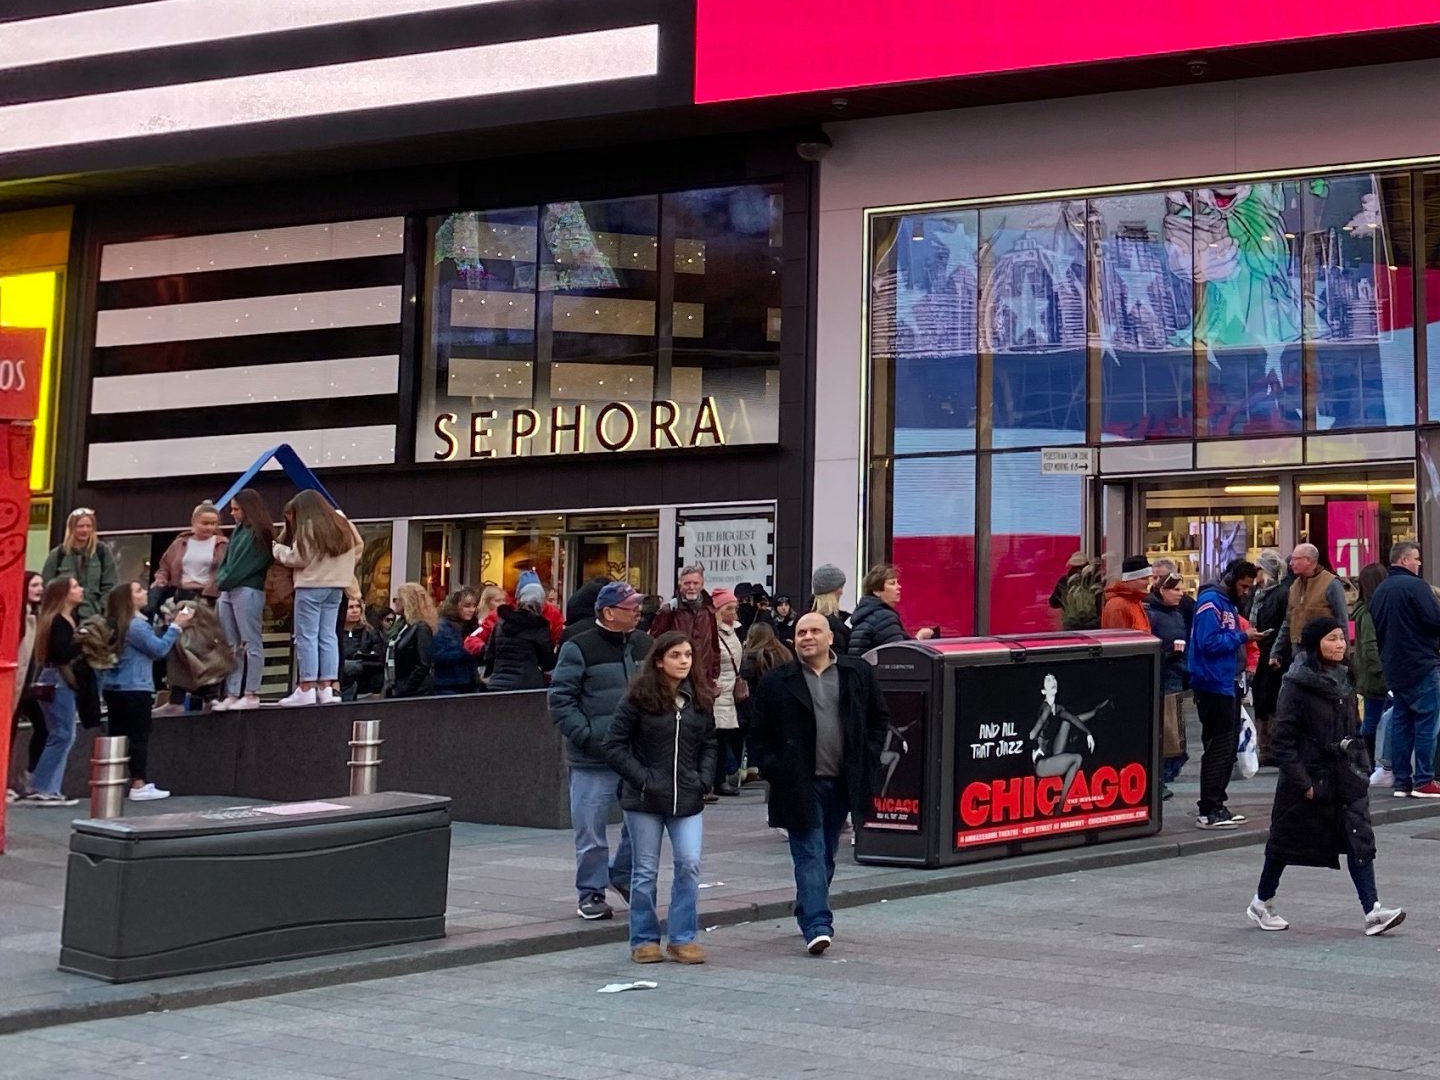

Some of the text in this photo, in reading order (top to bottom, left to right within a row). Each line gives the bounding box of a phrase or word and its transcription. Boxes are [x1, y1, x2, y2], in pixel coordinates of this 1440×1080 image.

[434, 396, 726, 461] SEPHORA
[697, 530, 757, 542] THE BIGGEST
[694, 543, 756, 558] SEPHORA
[709, 560, 730, 572] THE
[732, 559, 755, 571] USA
[979, 722, 1018, 739] AND ALL
[970, 740, 1024, 759] THAT JAZZ
[960, 763, 1147, 827] CHICAGO
